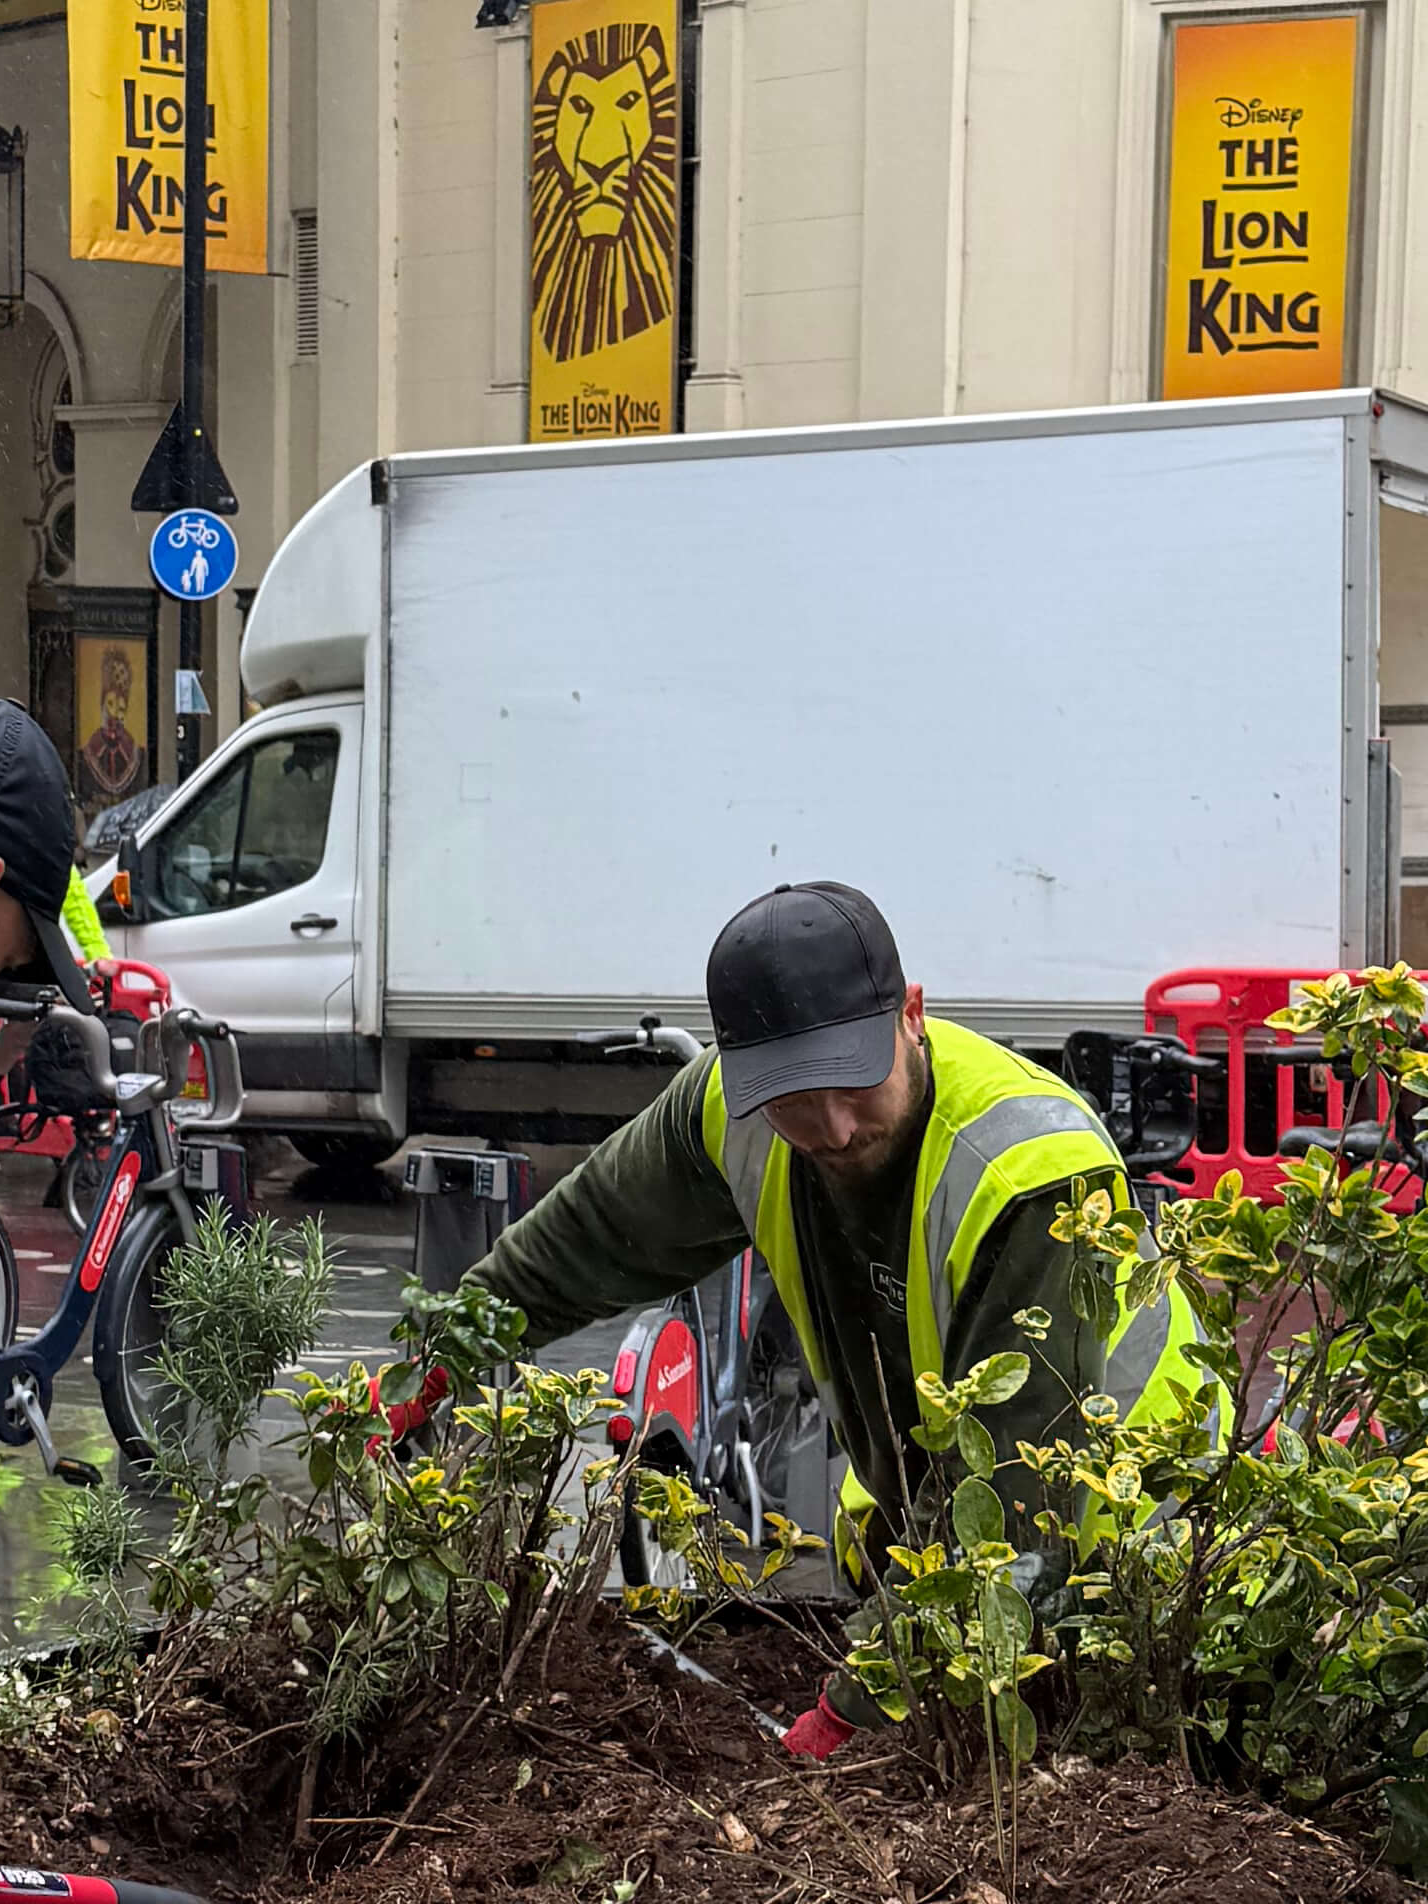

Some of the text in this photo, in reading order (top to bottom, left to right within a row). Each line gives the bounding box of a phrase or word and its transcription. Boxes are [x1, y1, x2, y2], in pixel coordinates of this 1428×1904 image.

[135, 22, 185, 65] TH
[1215, 97, 1303, 132] Disney
[1219, 137, 1300, 177] THE
[1202, 199, 1308, 270] LION
[1187, 277, 1320, 356] KING
[540, 394, 661, 435] THE LION KING
